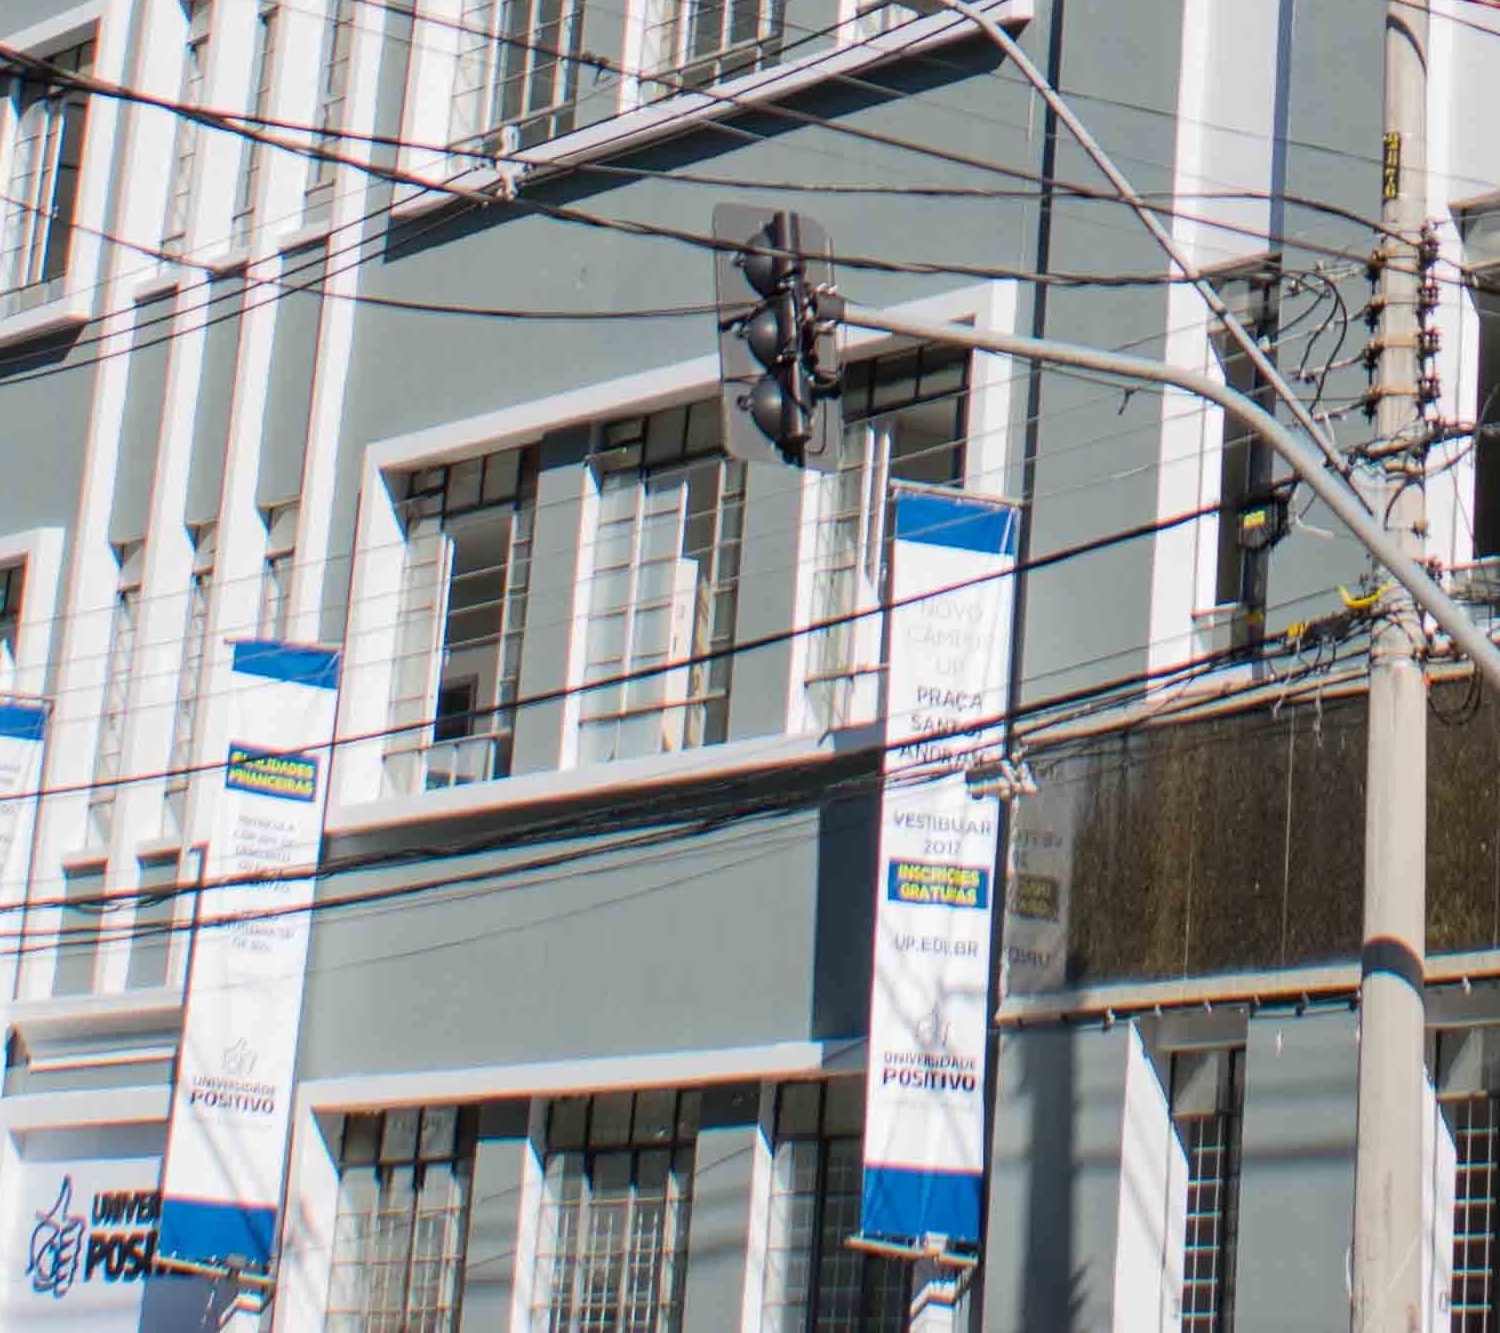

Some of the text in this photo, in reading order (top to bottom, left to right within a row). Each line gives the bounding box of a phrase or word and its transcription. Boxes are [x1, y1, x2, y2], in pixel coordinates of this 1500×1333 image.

[917, 685, 982, 711] PRAÇA
[229, 768, 314, 794] FINANCEIRAS
[893, 810, 992, 834] VESTIBULAR
[924, 839, 964, 854] 2017
[899, 884, 978, 907] GRATUITAS
[883, 1068, 976, 1091] POSITIVO
[190, 1091, 276, 1114] POSITIVO
